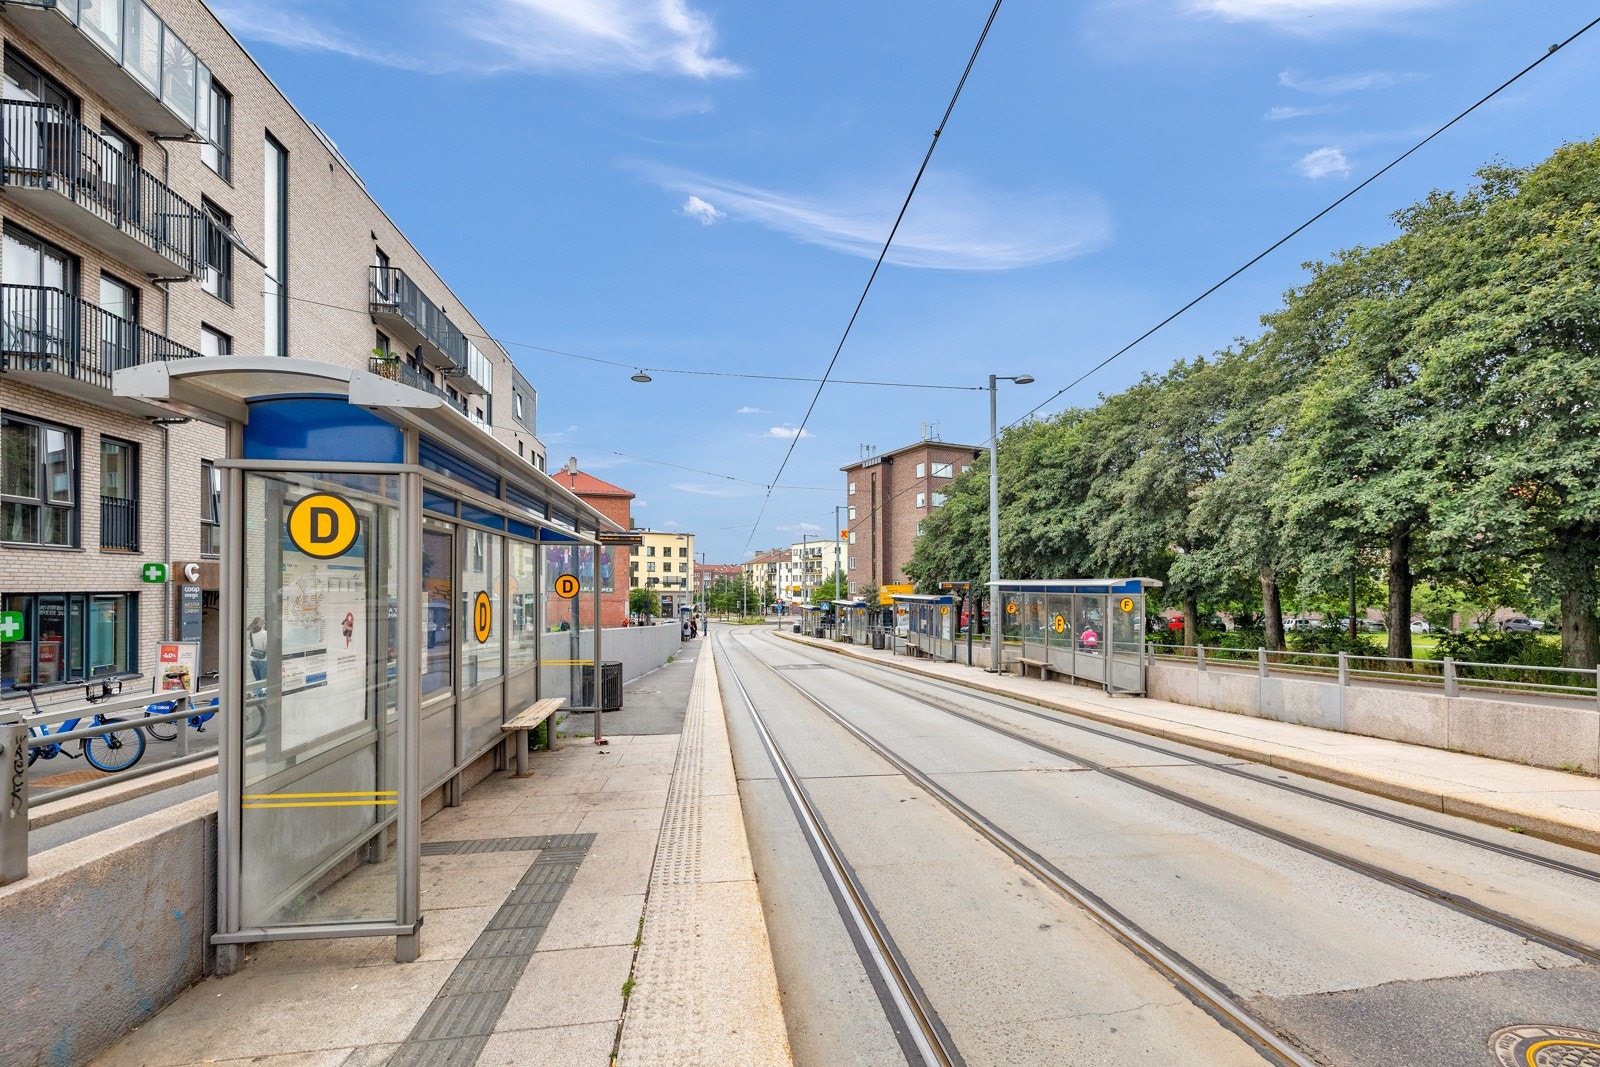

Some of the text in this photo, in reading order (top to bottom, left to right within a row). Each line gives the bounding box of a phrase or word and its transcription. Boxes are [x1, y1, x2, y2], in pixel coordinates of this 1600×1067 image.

[310, 507, 339, 544] D
[563, 580, 573, 593] D
[1124, 601, 1130, 609] F
[479, 602, 487, 632] D
[1057, 619, 1062, 630] F
